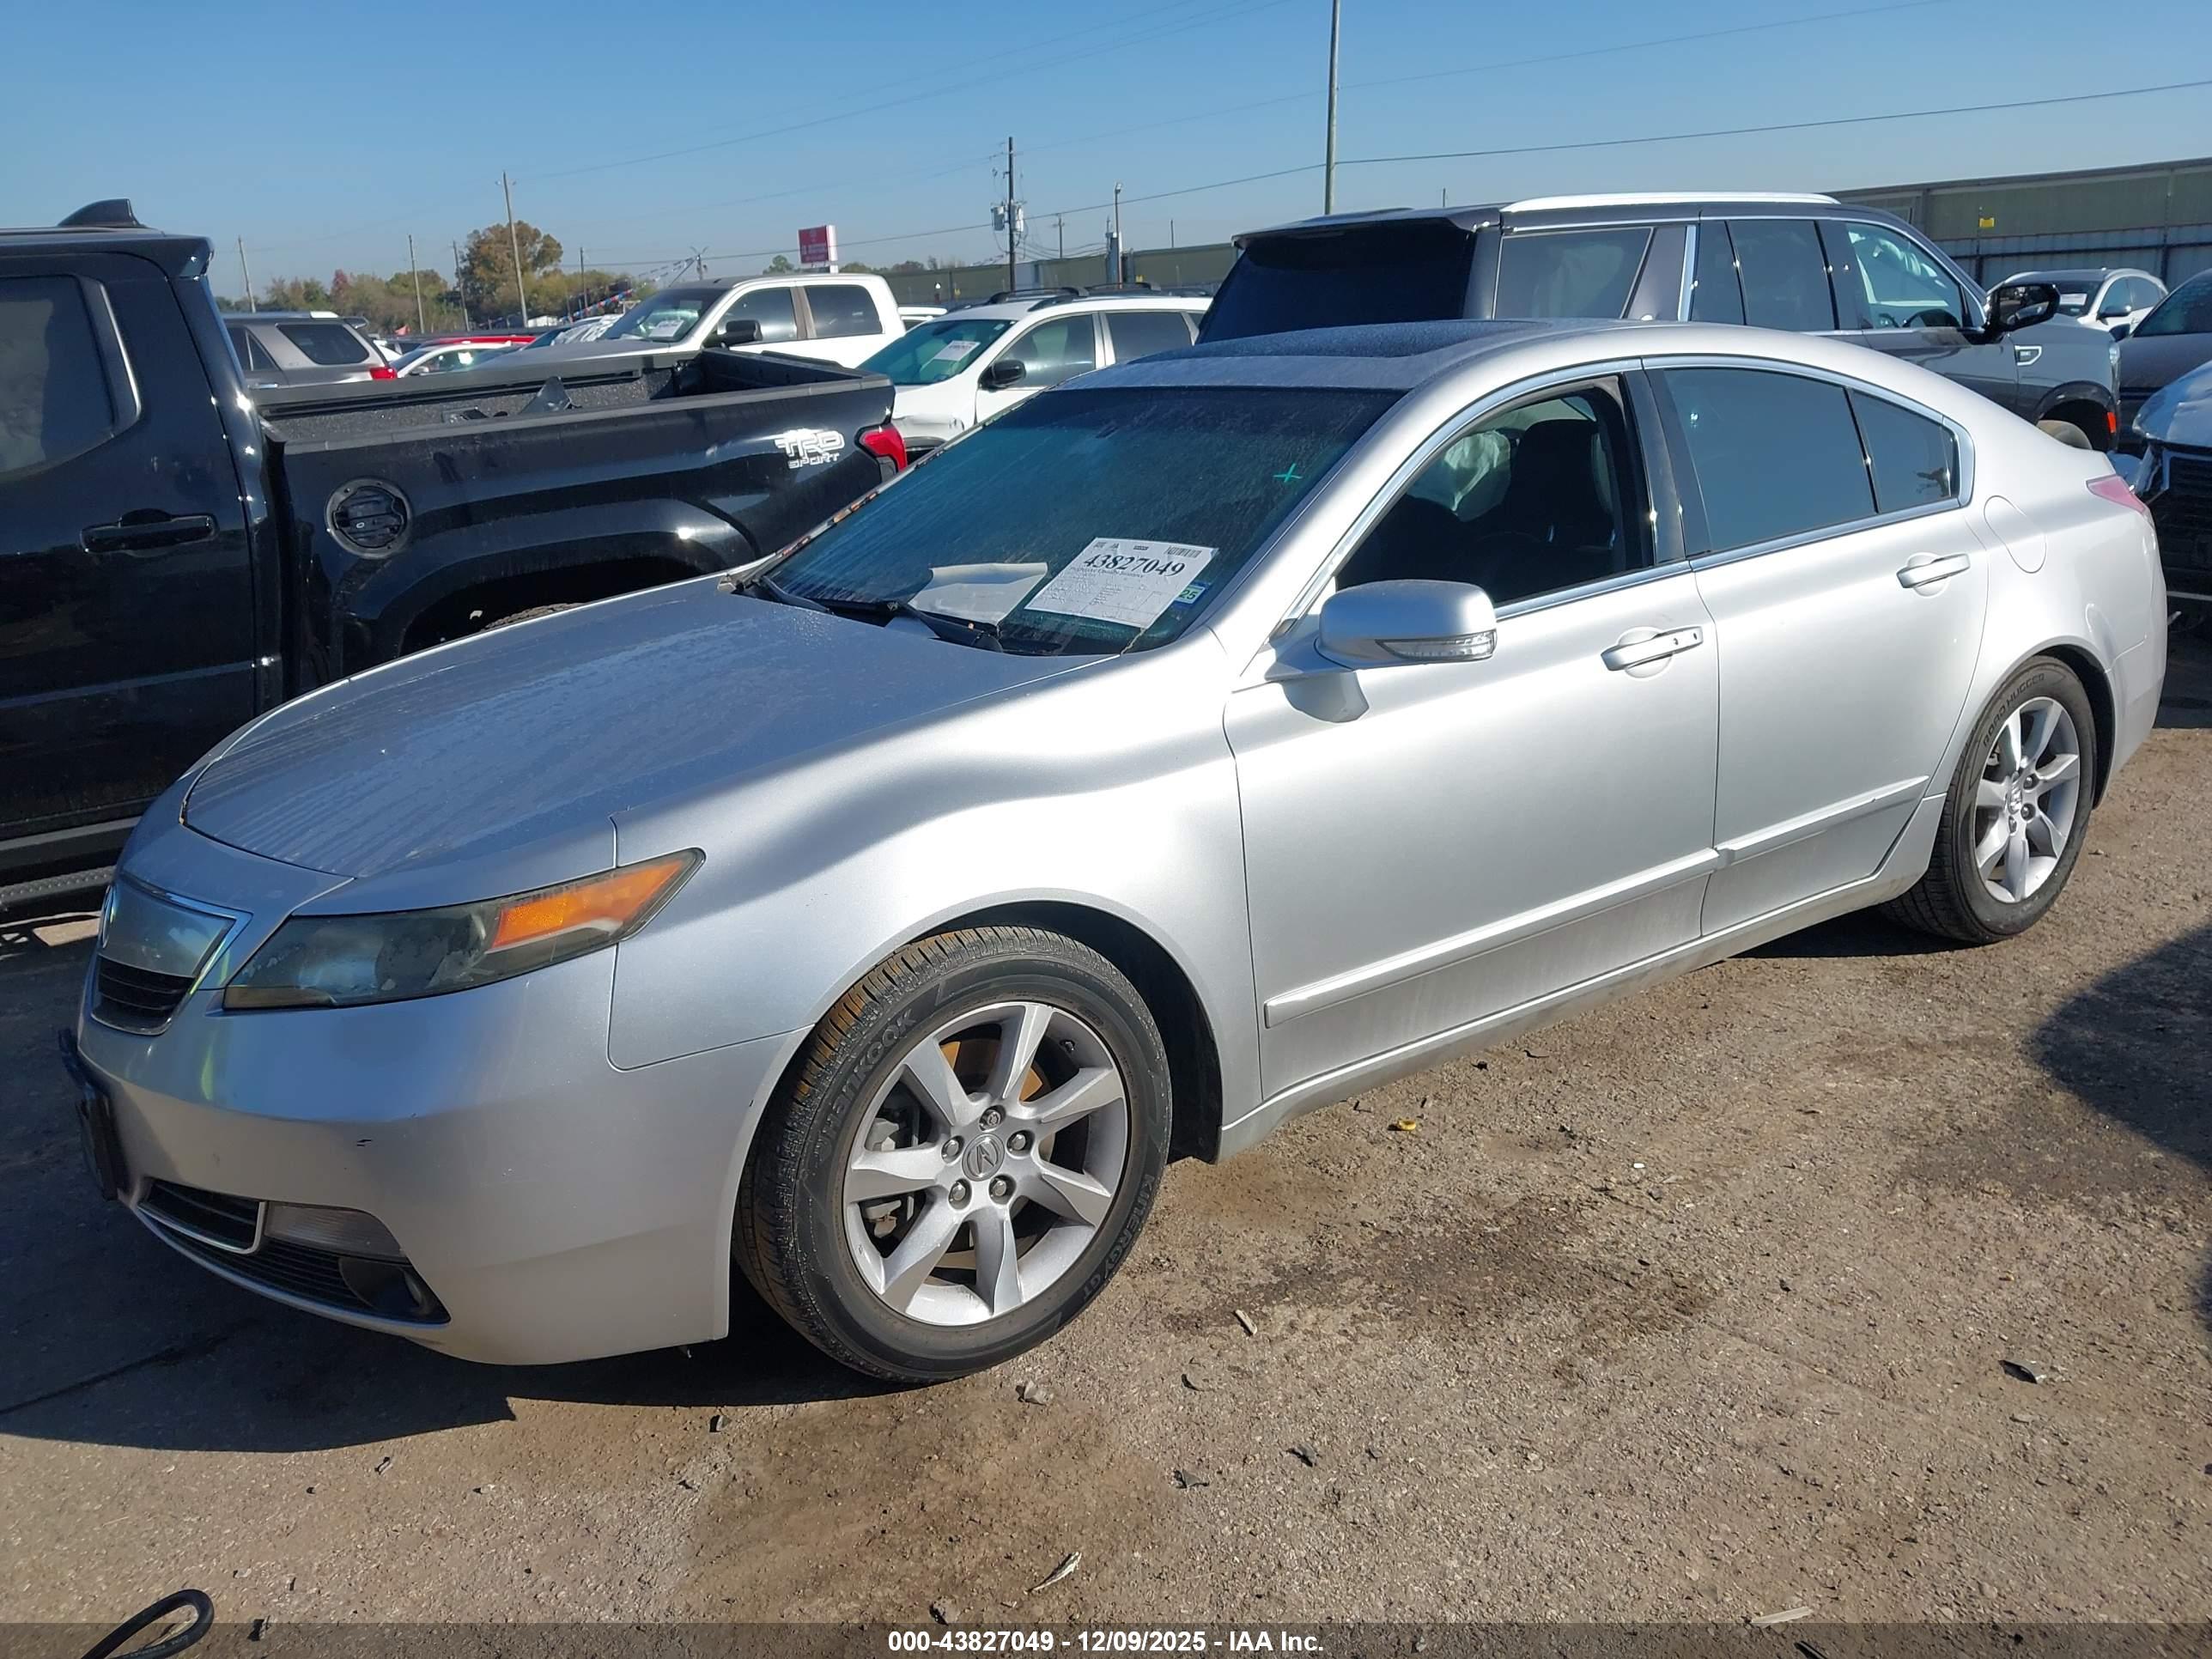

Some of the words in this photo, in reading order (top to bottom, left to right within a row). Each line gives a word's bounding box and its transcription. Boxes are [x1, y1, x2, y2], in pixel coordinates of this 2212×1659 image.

[775, 428, 845, 457] TRD
[788, 453, 840, 469] SPORT
[1084, 554, 1186, 577] 43827049
[1179, 589, 1199, 600] 25
